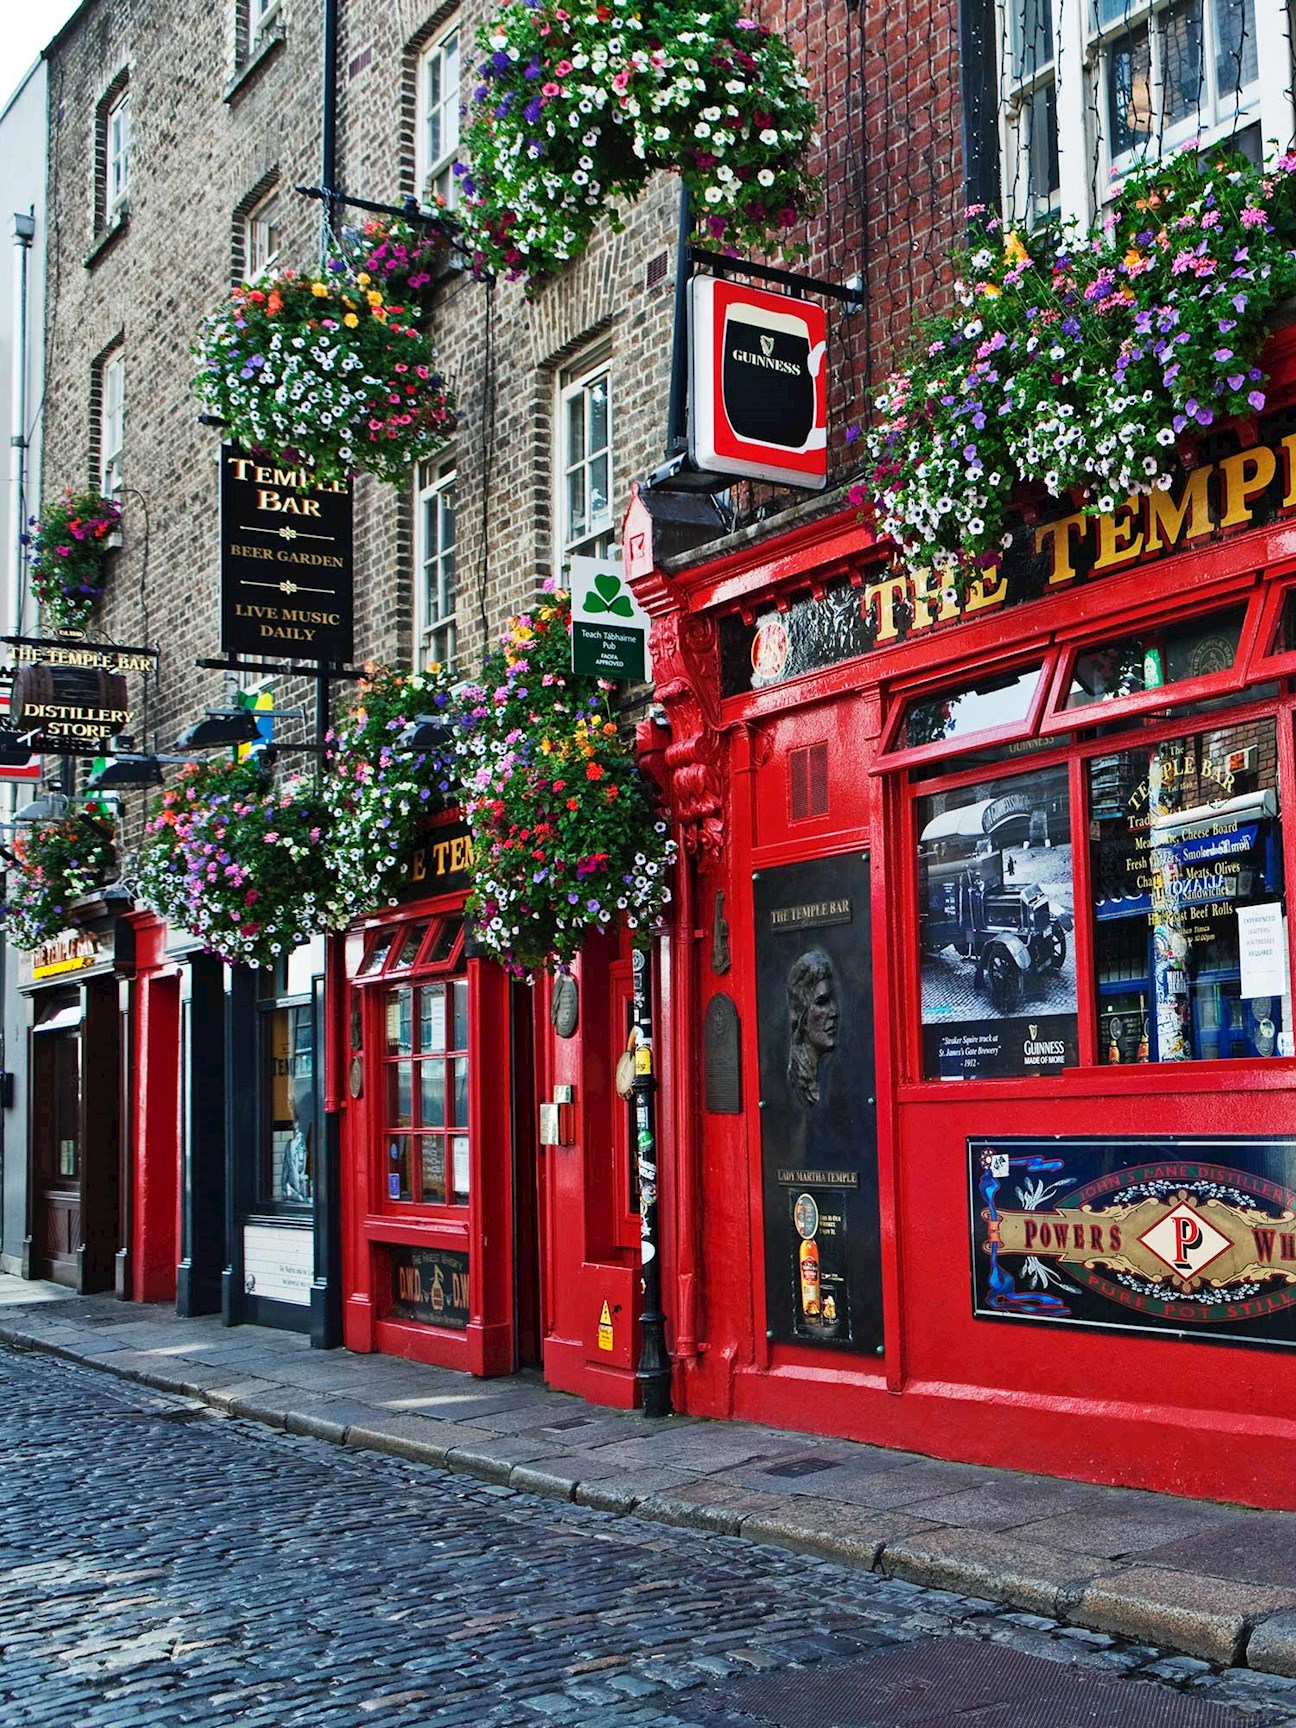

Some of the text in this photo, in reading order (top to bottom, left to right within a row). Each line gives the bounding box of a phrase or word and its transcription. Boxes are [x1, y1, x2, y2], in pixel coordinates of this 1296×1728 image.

[732, 349, 801, 377] GUINNESS
[256, 488, 322, 518] BAR
[230, 544, 345, 568] BEER GARDEN
[864, 558, 1009, 642] THE
[235, 603, 340, 626] LIVE MUSIC
[260, 624, 317, 642] DAILY
[581, 629, 602, 639] Teach
[602, 641, 616, 650] Pub
[8, 646, 152, 672] THE TEMPLE BAR
[595, 659, 625, 667] APPROVED
[24, 703, 135, 723] DISTILLERY
[47, 723, 112, 738] STORE
[1169, 745, 1184, 756] The
[1127, 756, 1236, 812] TEPLE BAR
[1181, 820, 1238, 841] Cheese Board
[1126, 856, 1148, 871] Fresh
[1185, 860, 1241, 880] Meats, Olives
[770, 899, 850, 924] THE TEMPLE BAR
[1190, 901, 1233, 920] Beef Rolls
[978, 1034, 992, 1043] truck
[1023, 1041, 1065, 1056] GUINNESS
[964, 1047, 977, 1056] Gate
[1024, 1055, 1065, 1064] MADE OF MORE
[777, 1170, 857, 1183] LADY MARTHA TEMPLE
[1143, 1165, 1189, 1179] LANE
[1198, 1165, 1296, 1206] DISTILLERY
[1023, 1218, 1123, 1254] POWERS
[1170, 1215, 1200, 1267] P
[400, 1266, 424, 1303] D.W.D.
[1087, 1276, 1295, 1320] PURE POT STILL
